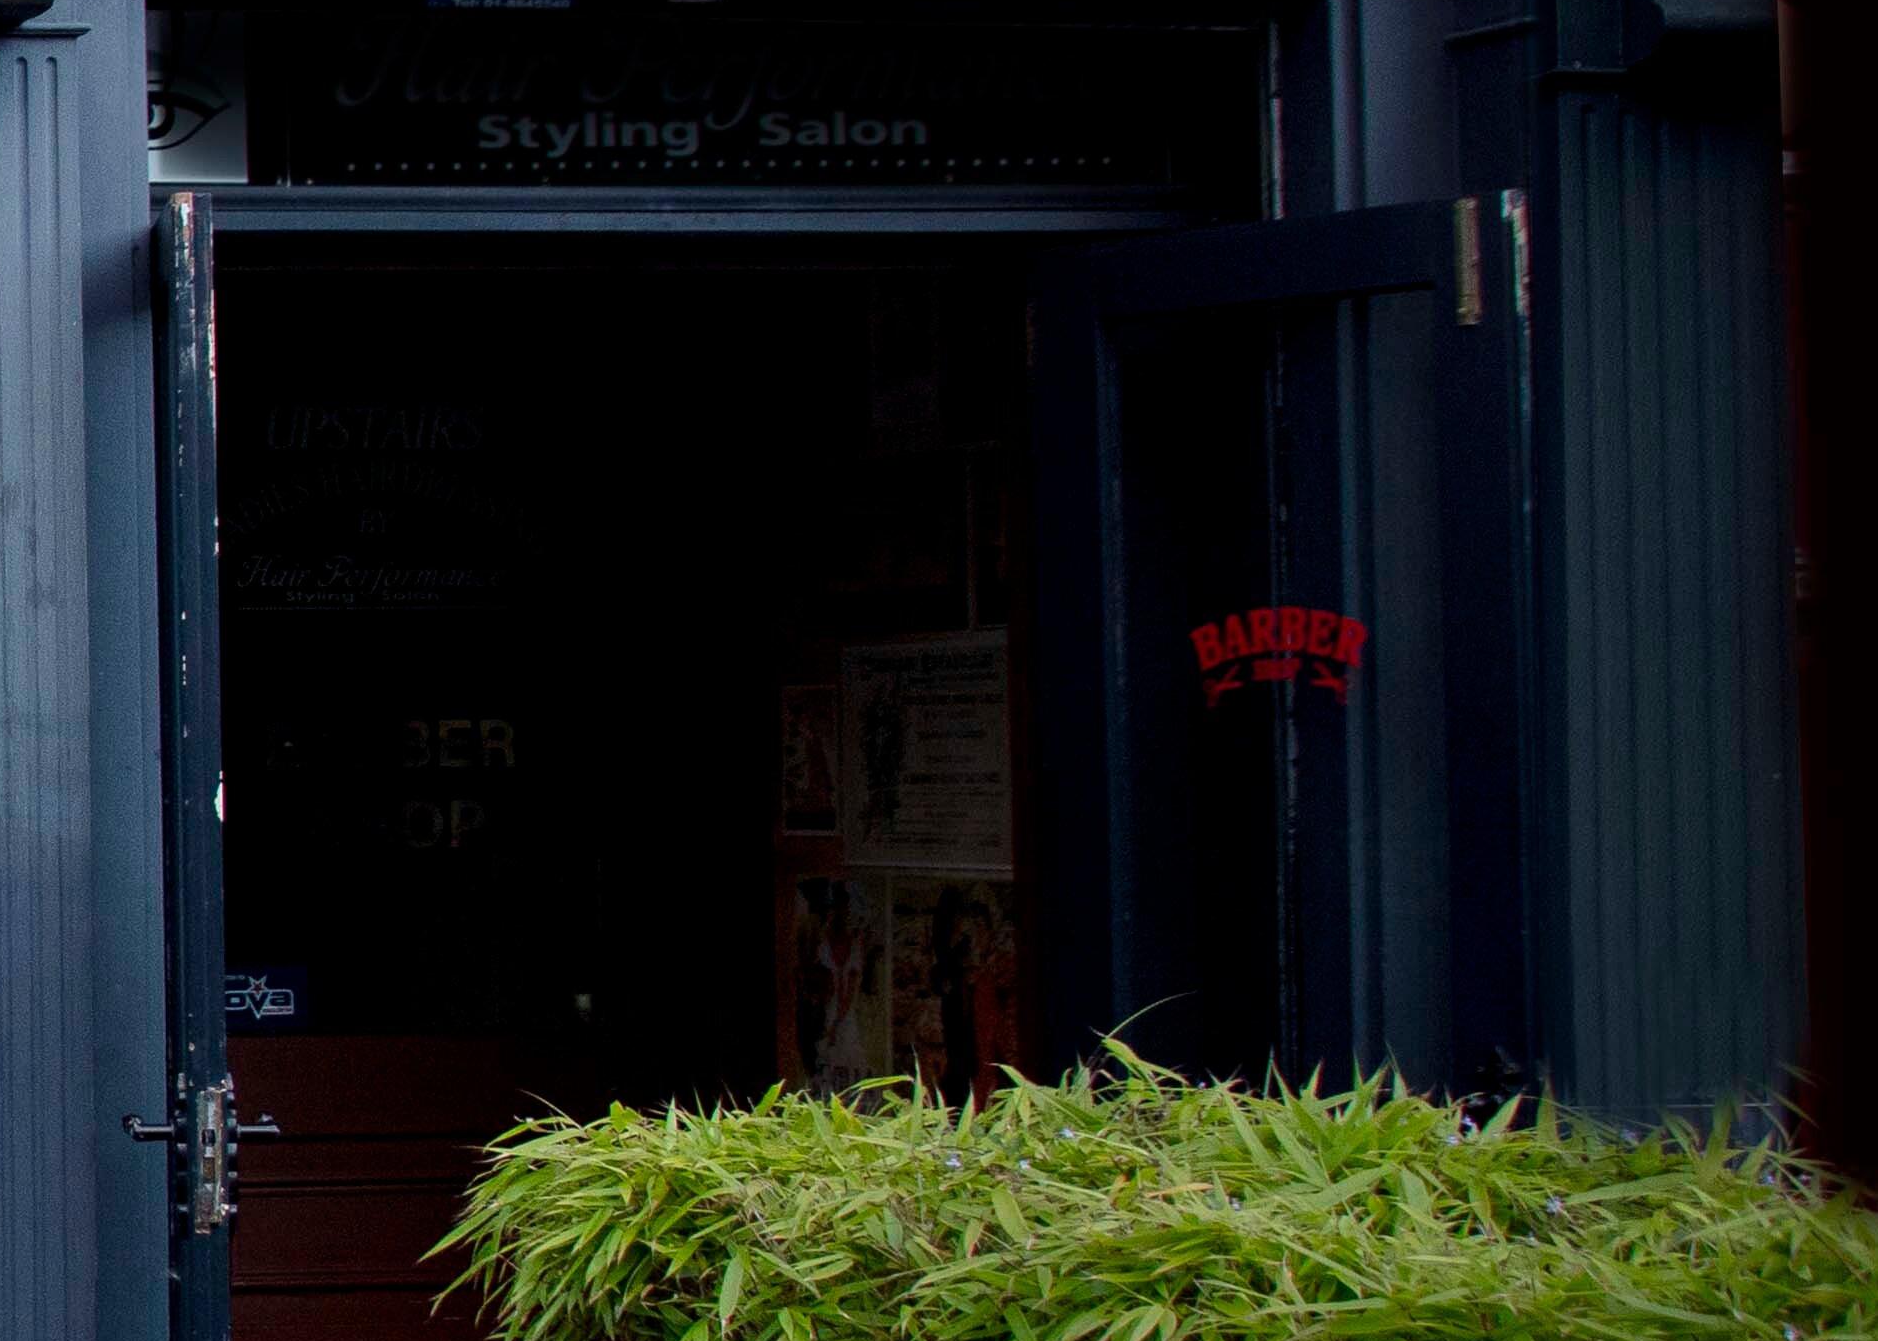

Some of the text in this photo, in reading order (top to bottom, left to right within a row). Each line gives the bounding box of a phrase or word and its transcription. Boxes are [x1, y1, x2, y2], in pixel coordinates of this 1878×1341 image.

[478, 110, 928, 158] Styling Salon
[1189, 606, 1369, 672] BARBER
